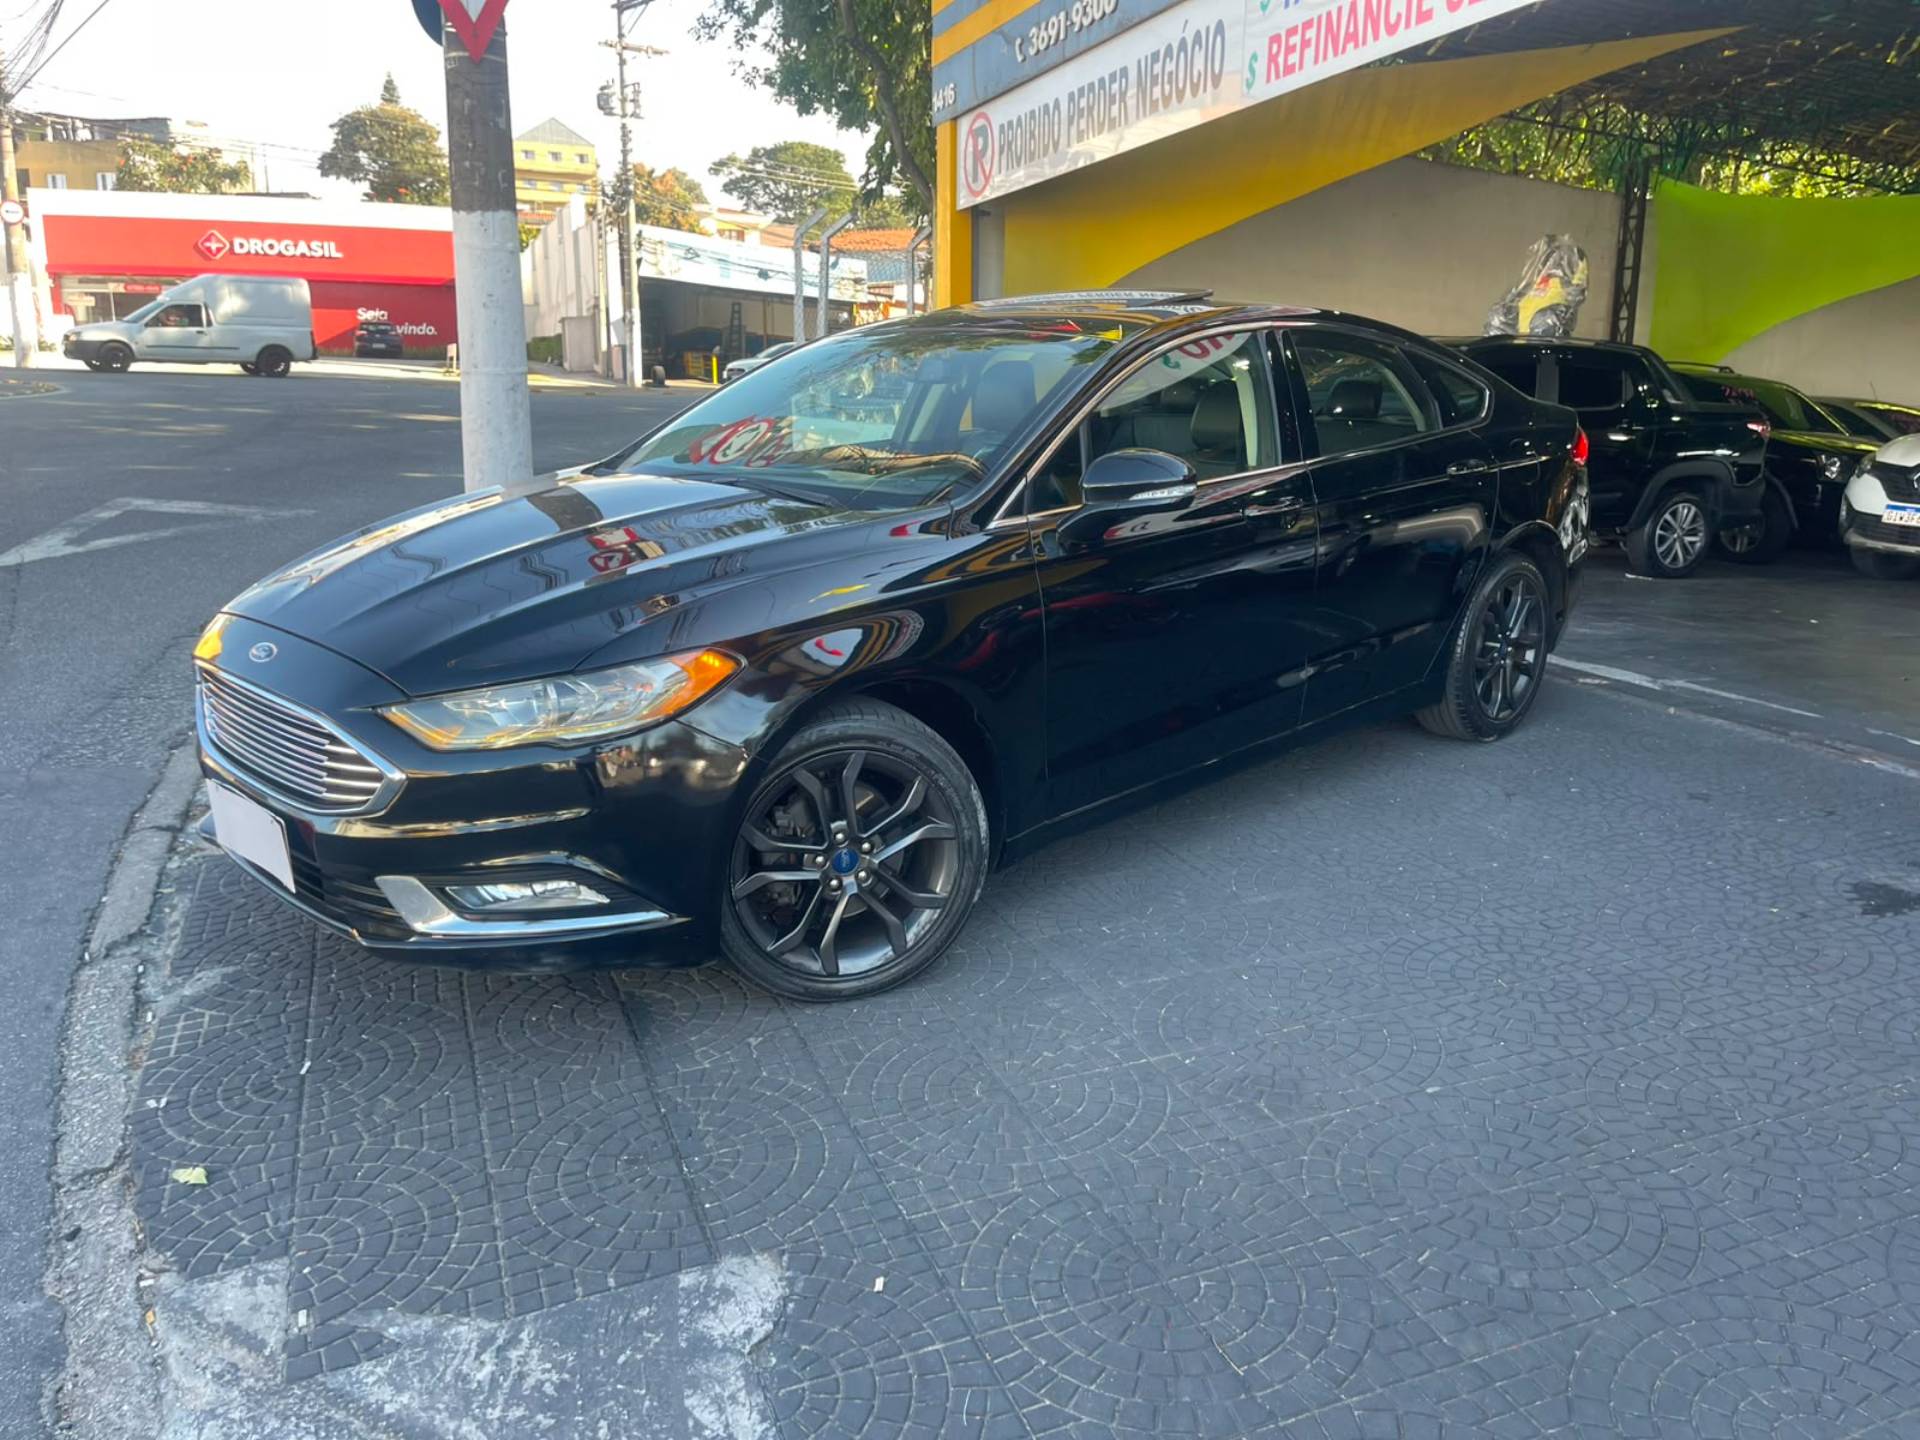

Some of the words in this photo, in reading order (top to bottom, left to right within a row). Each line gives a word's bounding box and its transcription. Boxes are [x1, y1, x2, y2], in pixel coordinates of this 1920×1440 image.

[1000, 97, 1061, 171] PROIBIDO
[1067, 65, 1130, 148] PERDER
[1137, 19, 1226, 120] NEGÓCIO
[233, 237, 343, 258] DROGASIL
[356, 307, 388, 322] Seja
[396, 323, 437, 335] vindo.
